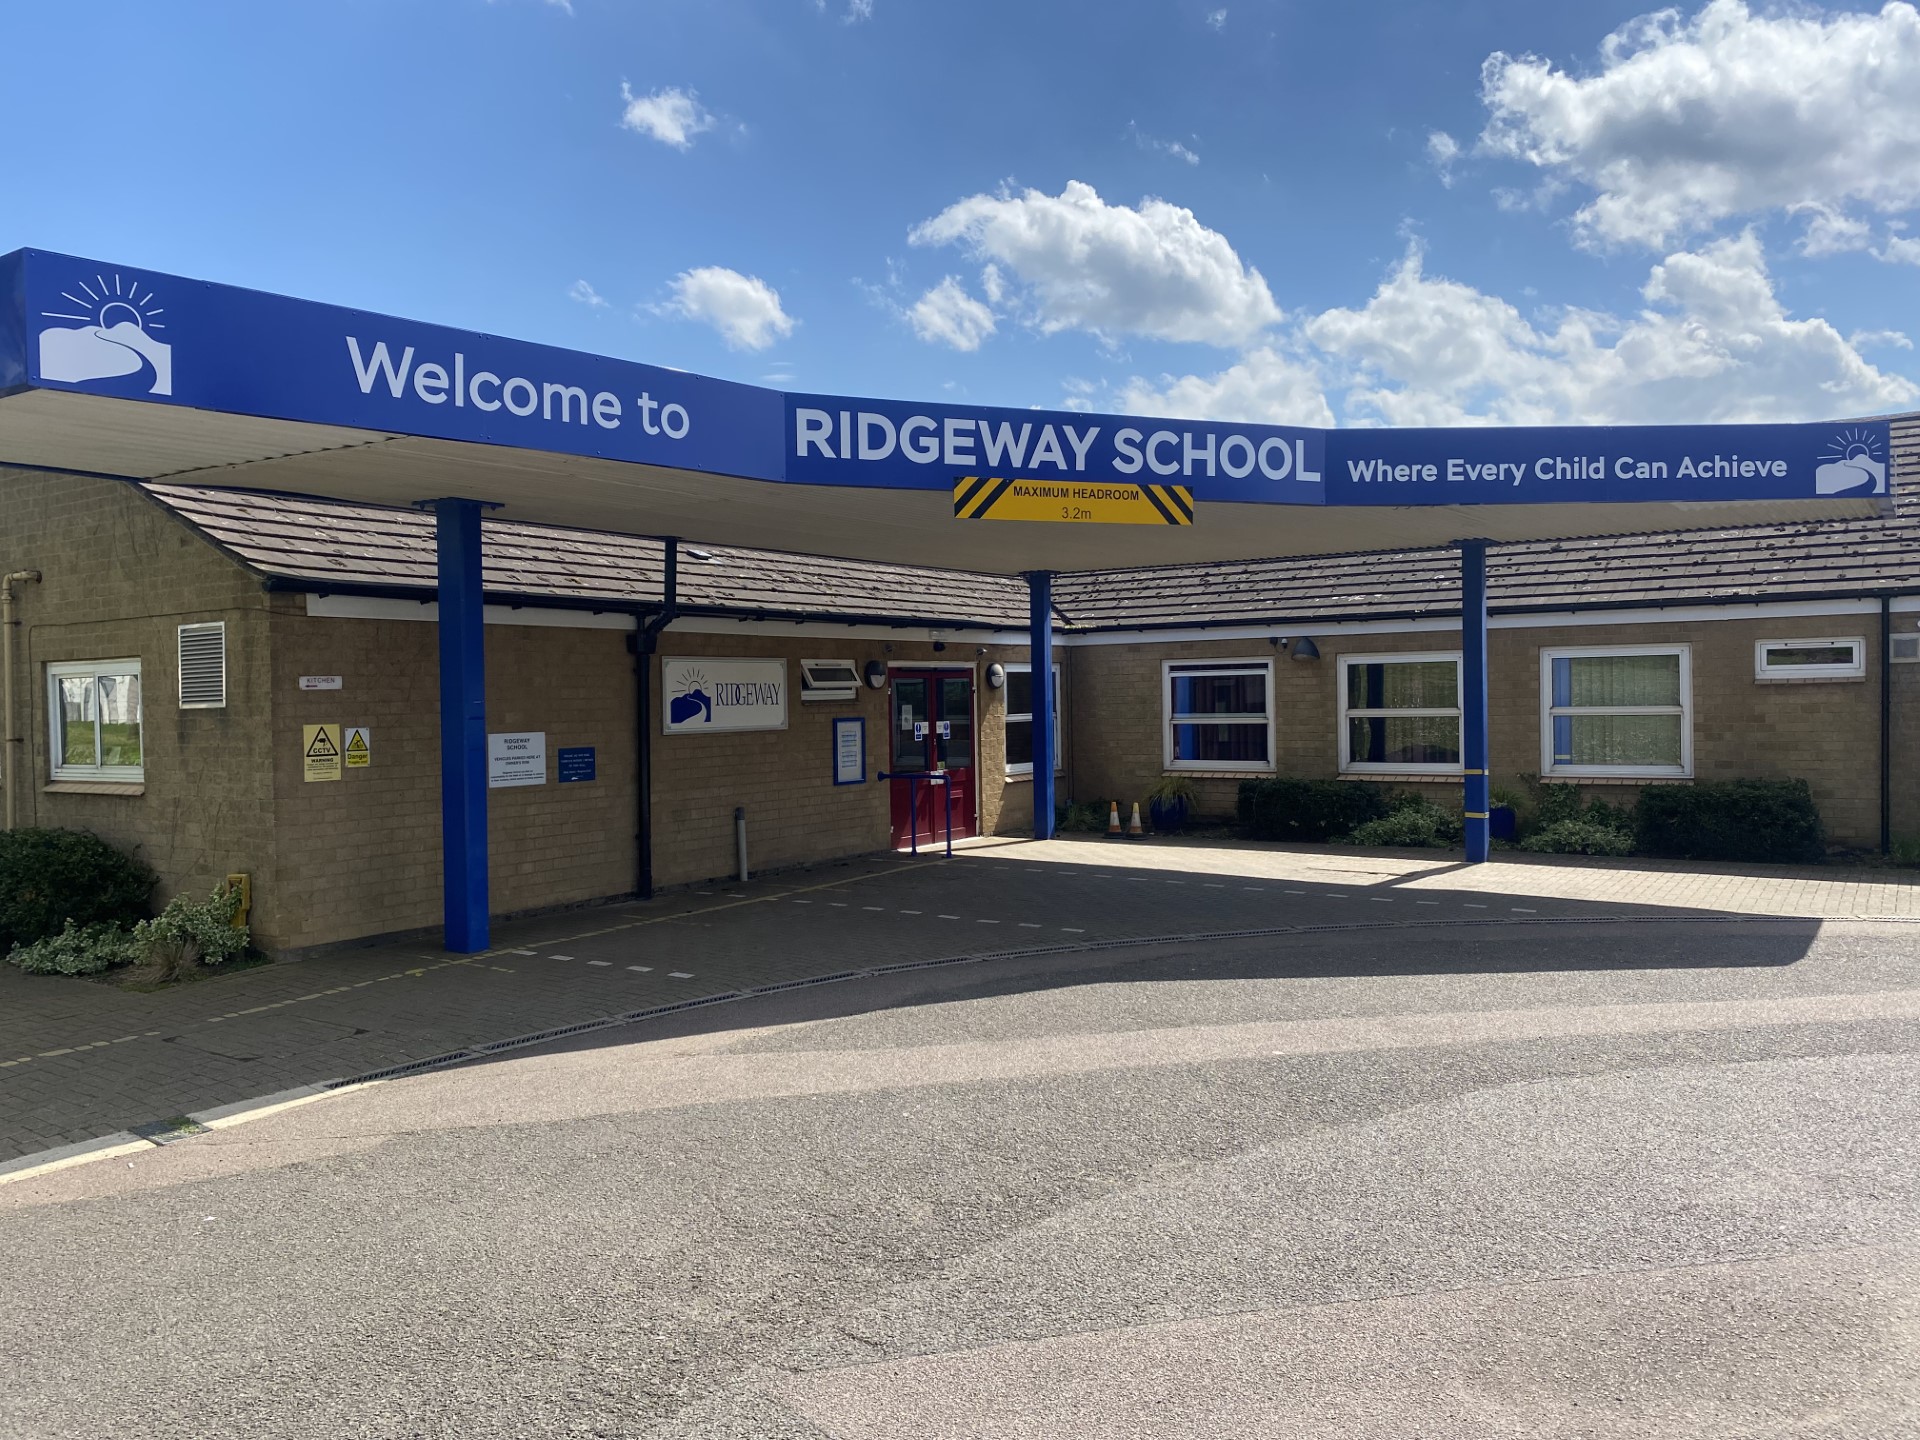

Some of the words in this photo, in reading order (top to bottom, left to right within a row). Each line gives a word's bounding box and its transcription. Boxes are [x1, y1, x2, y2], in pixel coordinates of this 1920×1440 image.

[345, 335, 622, 430] Welcome
[637, 391, 690, 440] to
[795, 407, 1101, 472] RIDGEWAY
[1111, 427, 1322, 483] SCHOOL
[1346, 458, 1438, 483] Where
[1446, 458, 1527, 487] Every
[1534, 455, 1606, 481] Child
[1614, 456, 1668, 480] Can
[1675, 454, 1788, 479] Achieve
[1013, 485, 1070, 499] MAXIMUM
[1072, 488, 1139, 501] HEADROOM
[1061, 506, 1092, 520] 3.2m
[715, 682, 781, 707] RIDGEWAY
